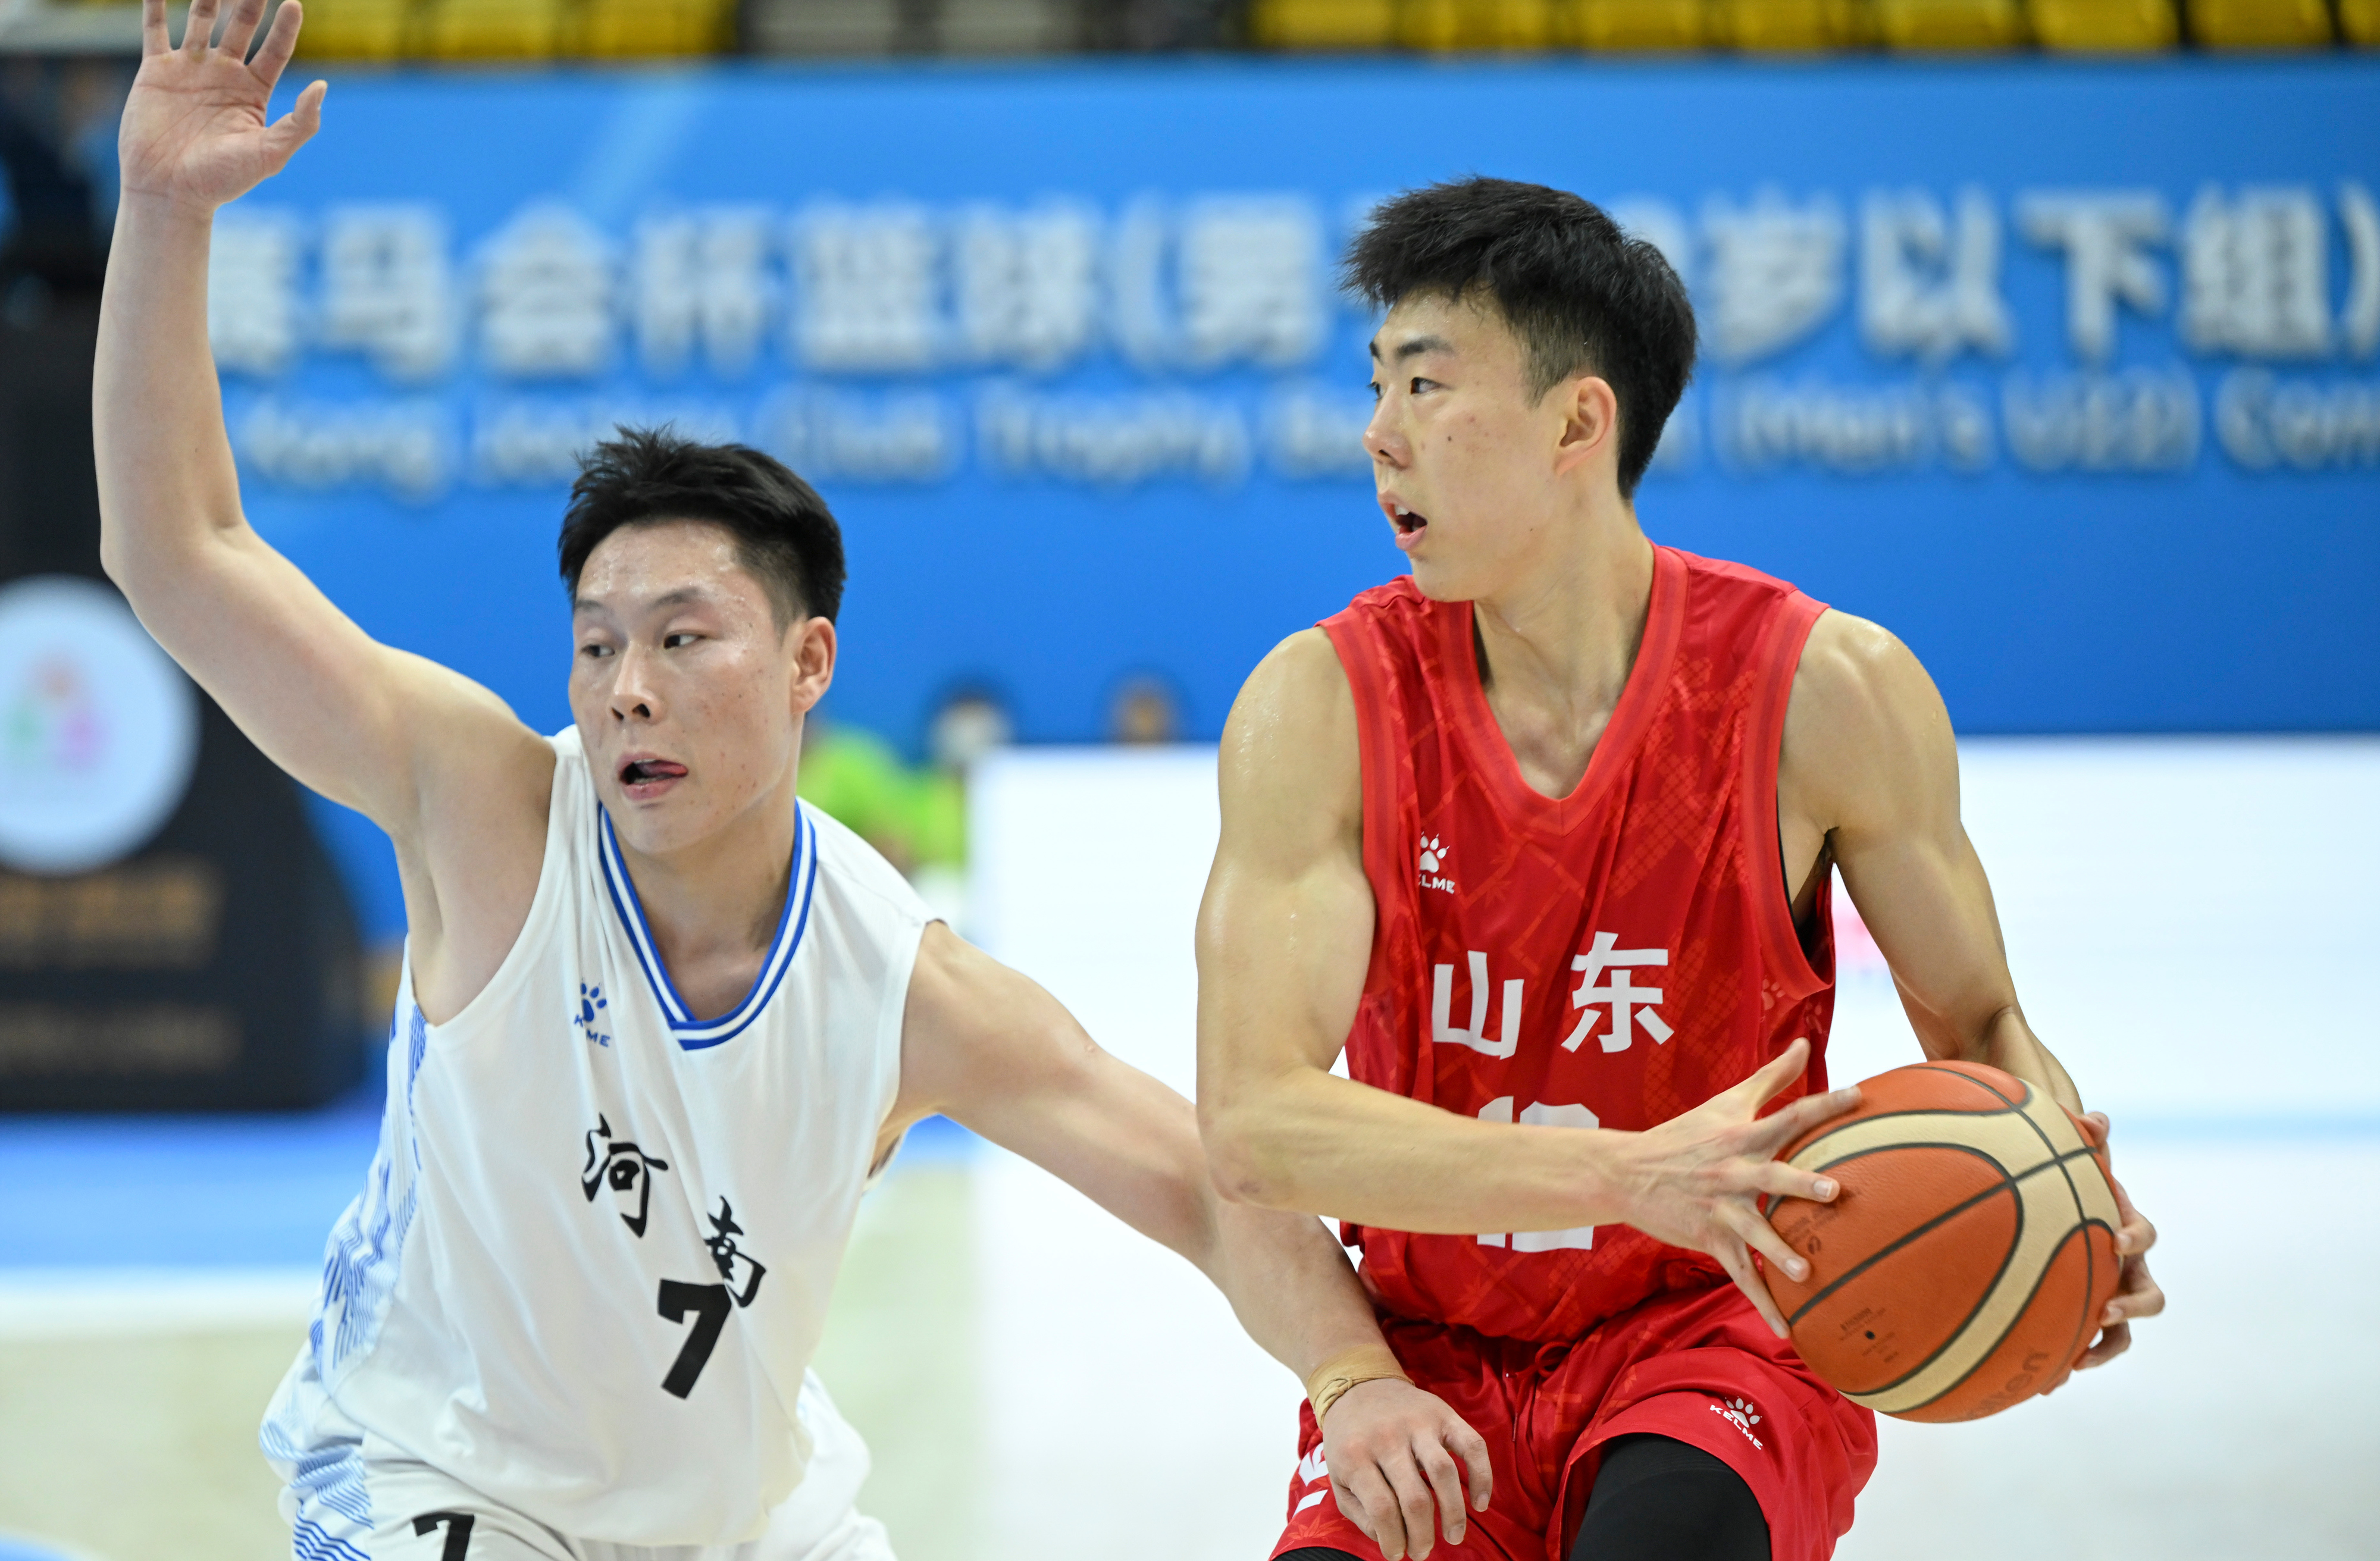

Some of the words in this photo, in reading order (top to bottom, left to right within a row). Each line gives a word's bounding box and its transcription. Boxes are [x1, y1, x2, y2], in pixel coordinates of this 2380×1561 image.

[1418, 873, 1455, 895] LME
[574, 1013, 611, 1048] KME
[1432, 930, 1675, 1060] 山东
[581, 1112, 766, 1308] 河南
[657, 1278, 732, 1400] 7
[1709, 1404, 1764, 1450] KELME
